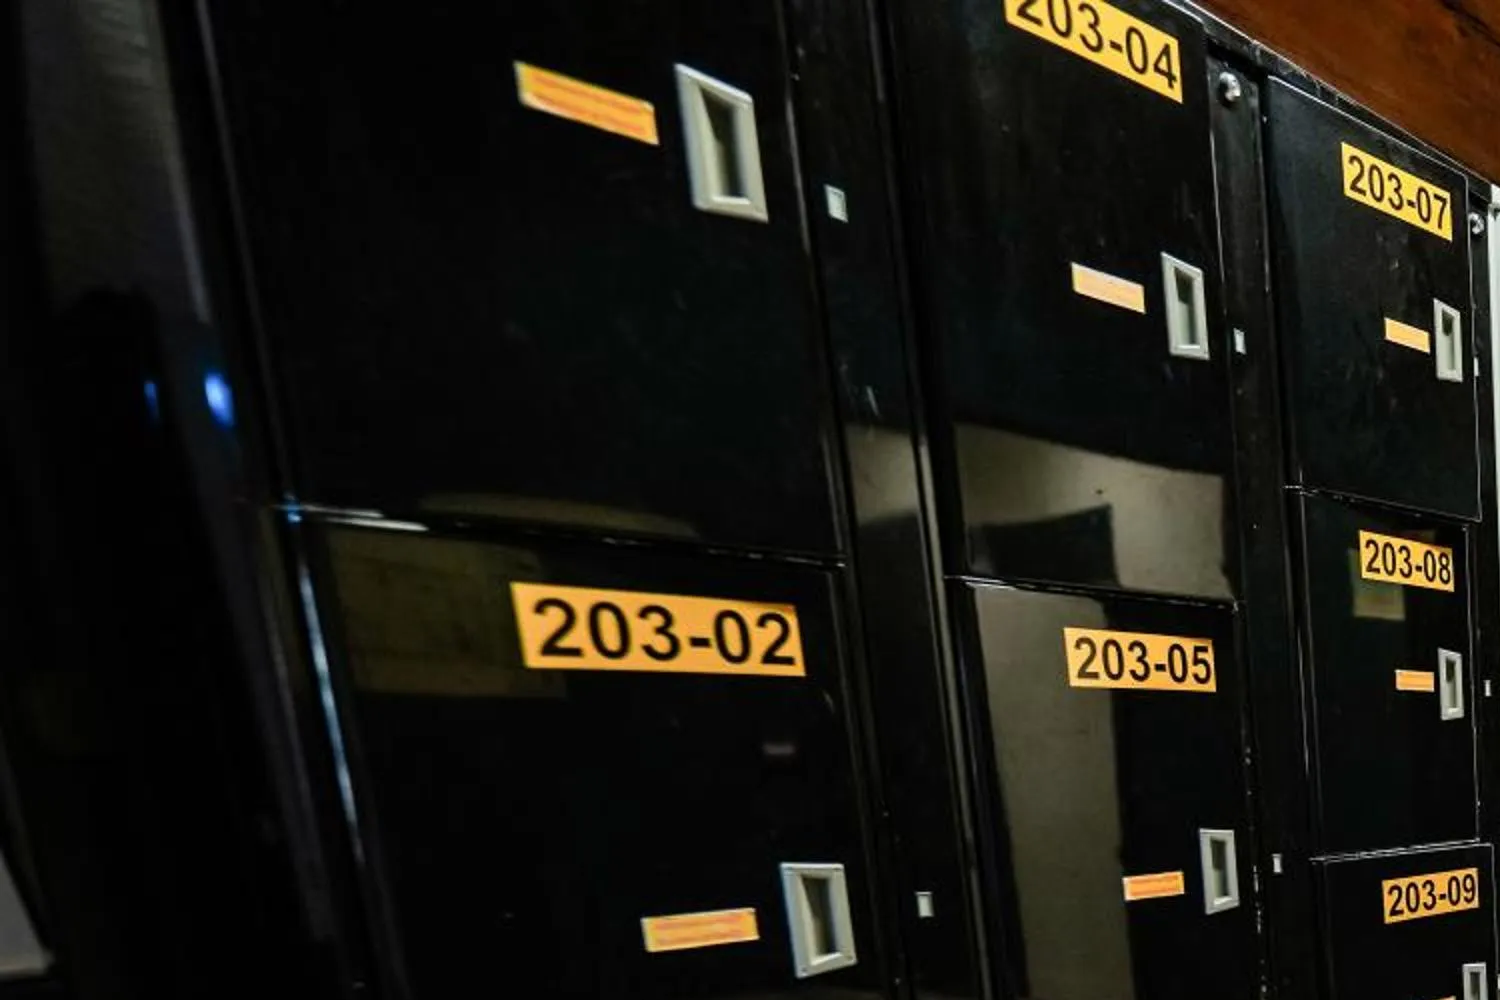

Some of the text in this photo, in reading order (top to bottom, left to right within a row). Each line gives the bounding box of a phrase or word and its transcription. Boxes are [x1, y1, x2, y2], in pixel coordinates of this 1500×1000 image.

[1349, 155, 1449, 229] 203-07
[1365, 539, 1450, 584] 203-08
[533, 598, 796, 666] 203-02
[1074, 636, 1212, 685] 203-05
[1388, 874, 1476, 917] 203-09
